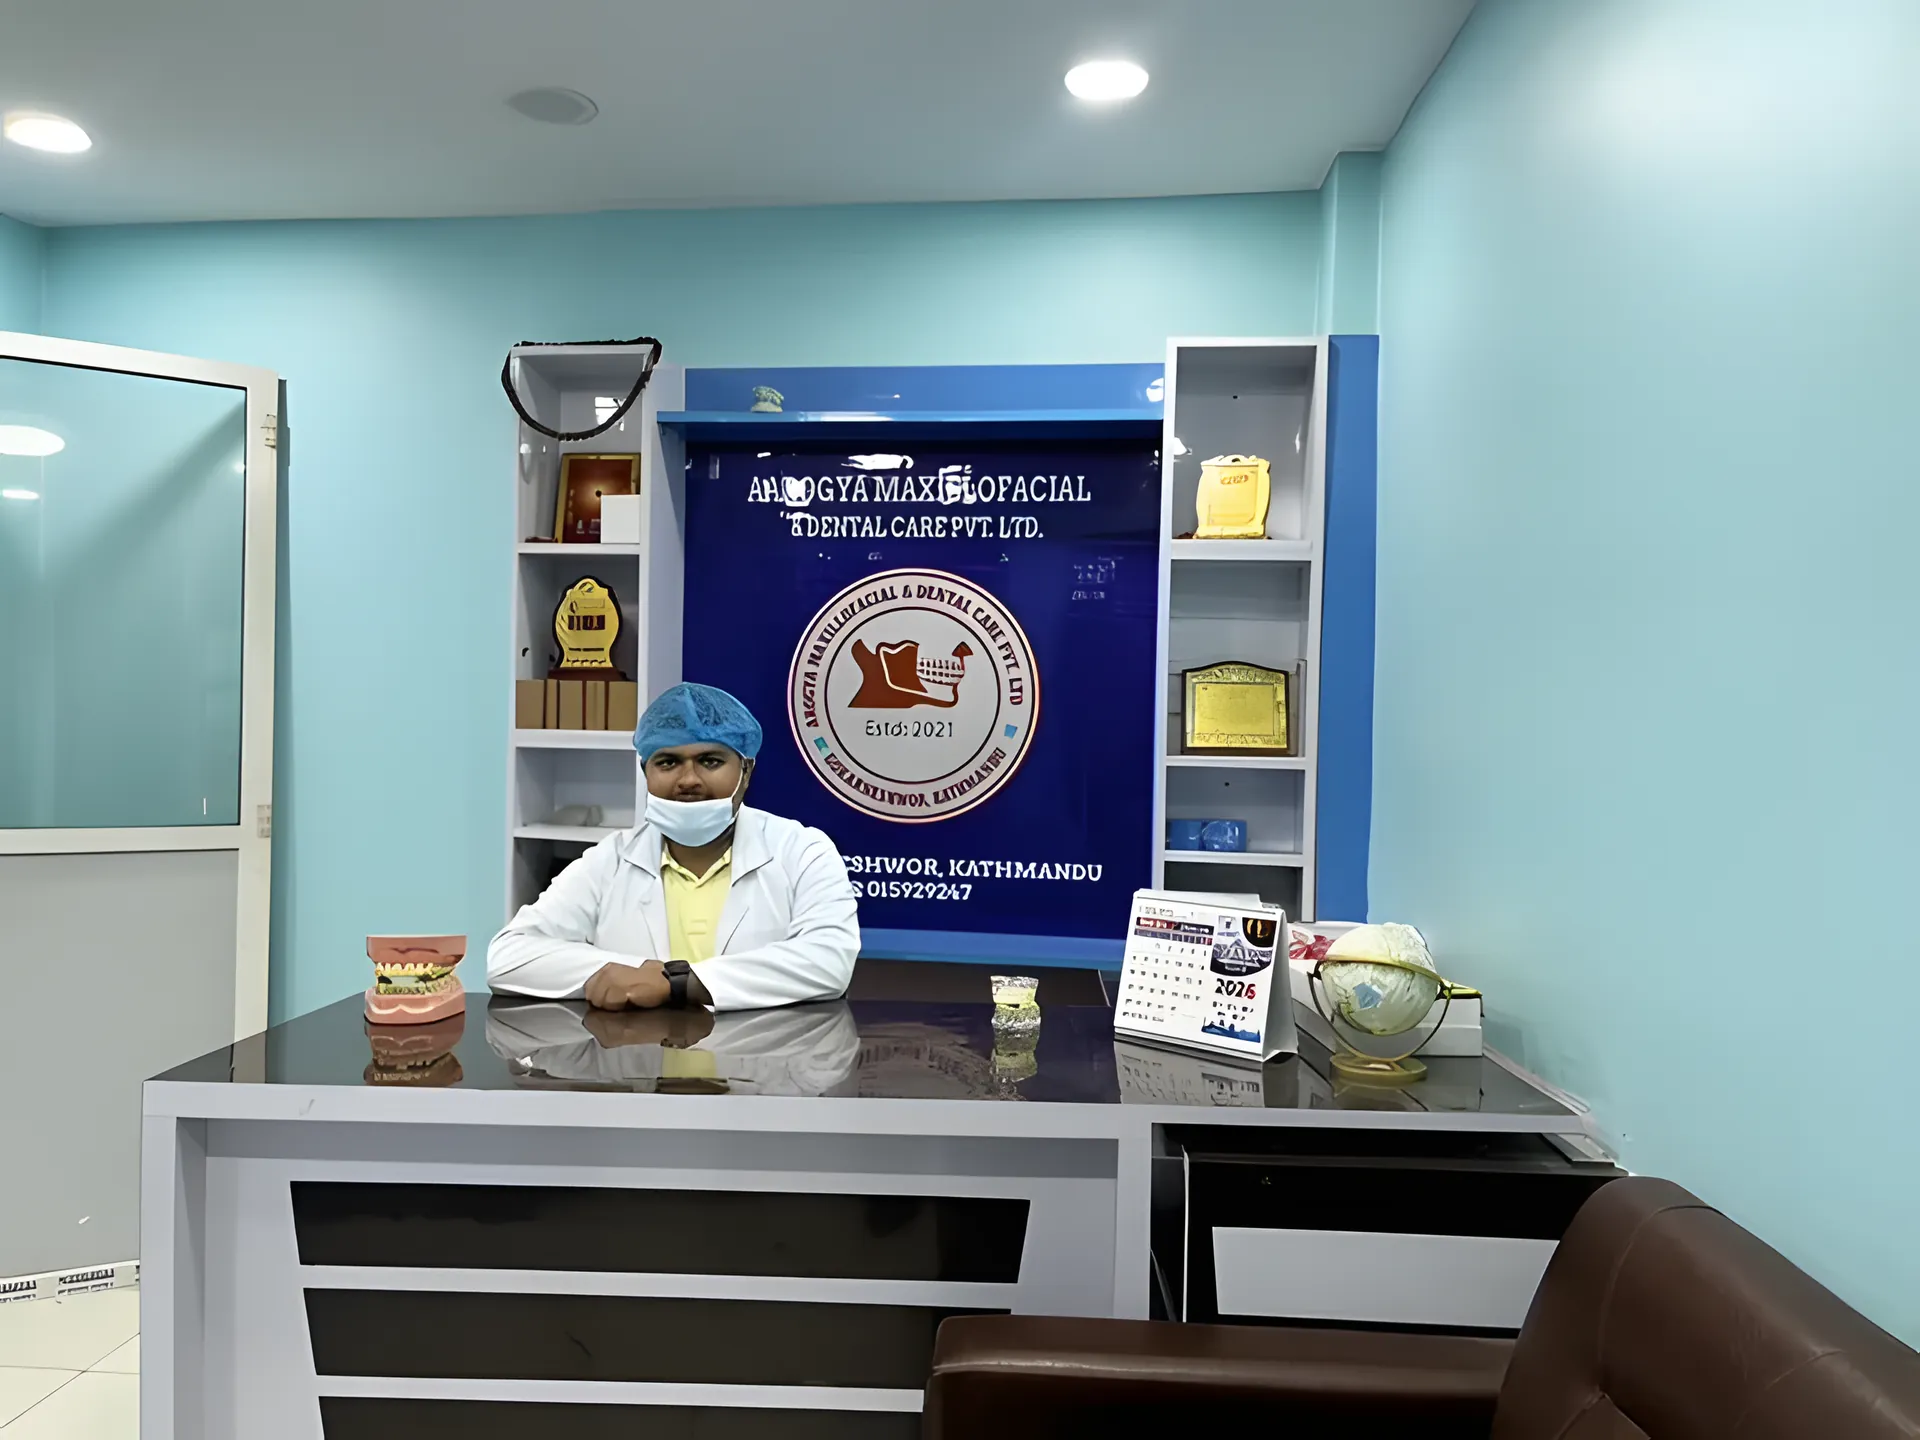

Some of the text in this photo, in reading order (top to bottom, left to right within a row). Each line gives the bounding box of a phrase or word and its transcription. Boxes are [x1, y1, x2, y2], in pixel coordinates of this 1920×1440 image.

[873, 474, 1091, 502] MAXILOFACIAL
[807, 515, 888, 538] DENTAL
[890, 515, 948, 538] CARE
[951, 516, 994, 539] PVT.
[999, 515, 1044, 539] LTD.
[912, 720, 953, 738] 2021
[948, 858, 1103, 882] KATHMANDU
